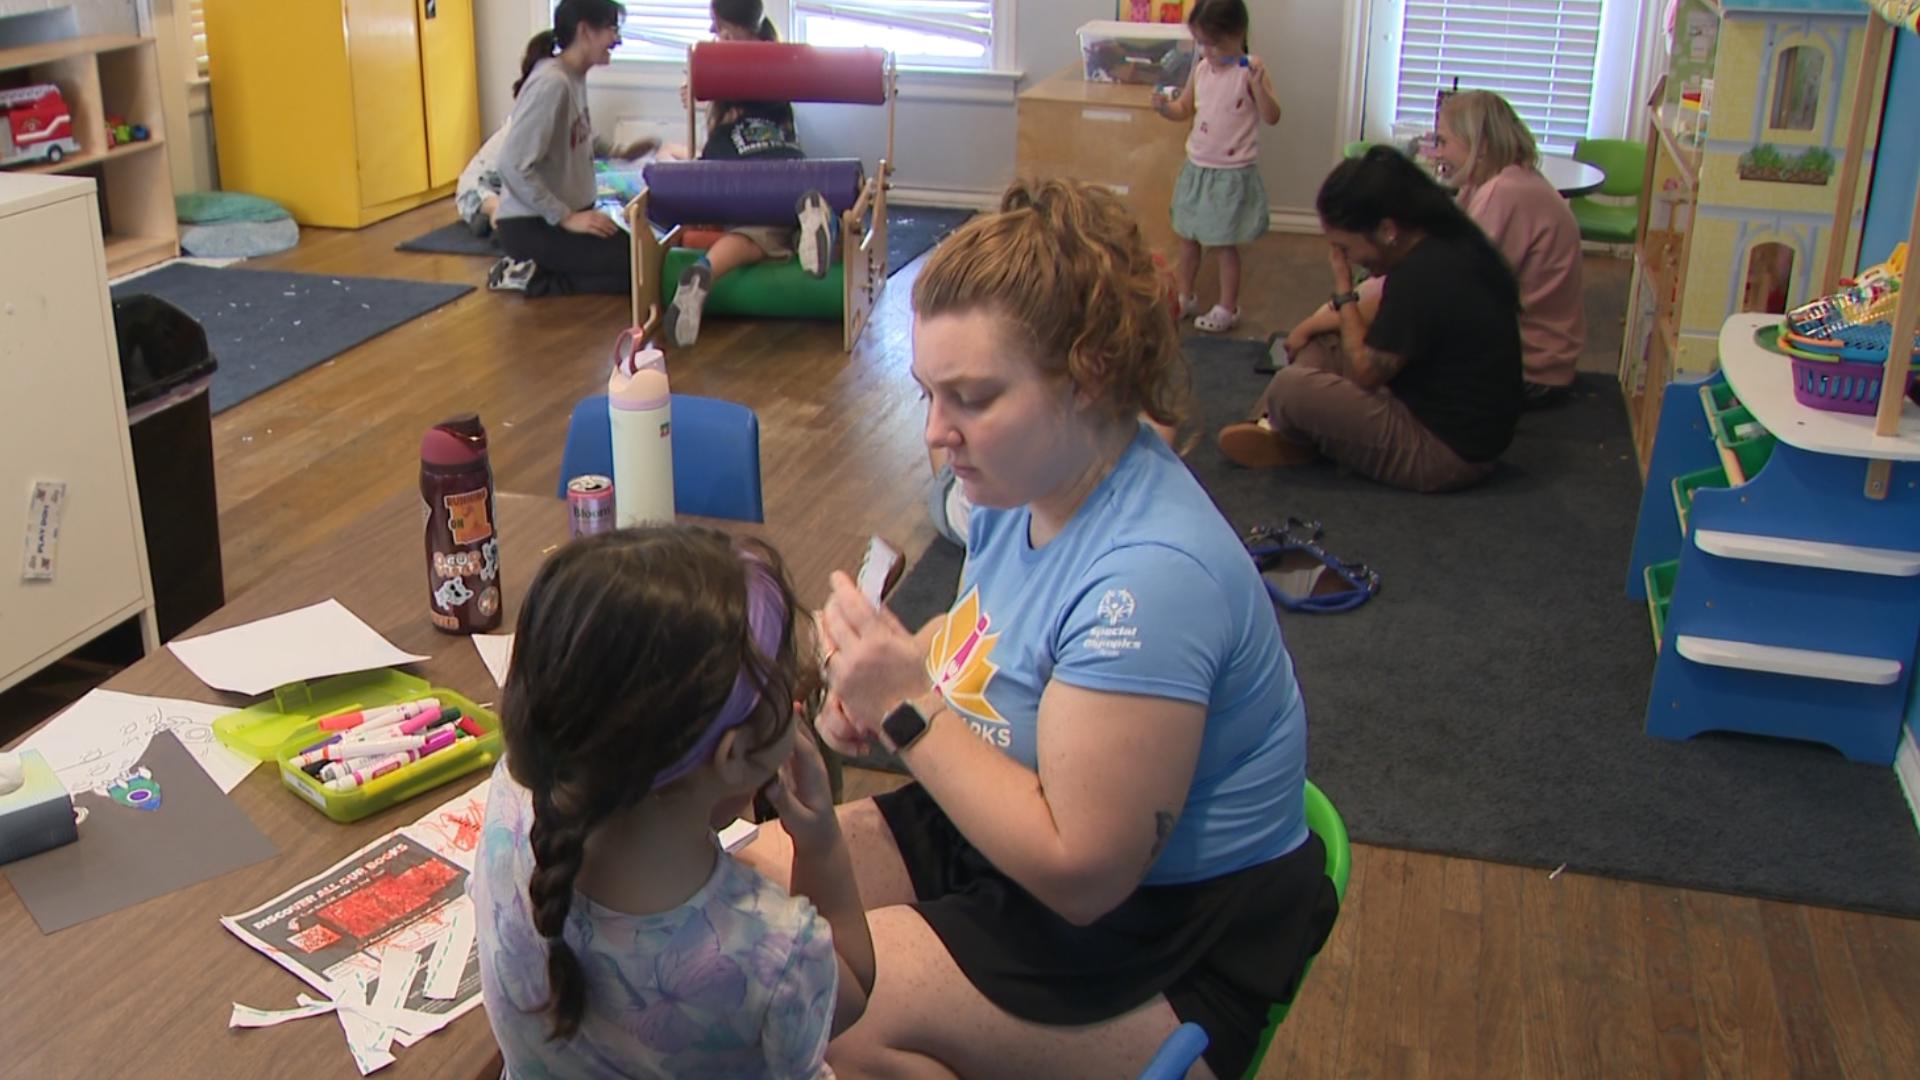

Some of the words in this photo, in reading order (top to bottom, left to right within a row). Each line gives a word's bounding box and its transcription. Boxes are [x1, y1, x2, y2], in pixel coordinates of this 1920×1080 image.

[574, 504, 611, 519] Bloom
[1089, 625, 1137, 639] Special
[1083, 638, 1142, 650] Olympics
[252, 893, 317, 931] DISCOVER
[316, 883, 342, 900] ALL
[338, 866, 368, 888] OUR
[365, 842, 409, 873] BOOKS
